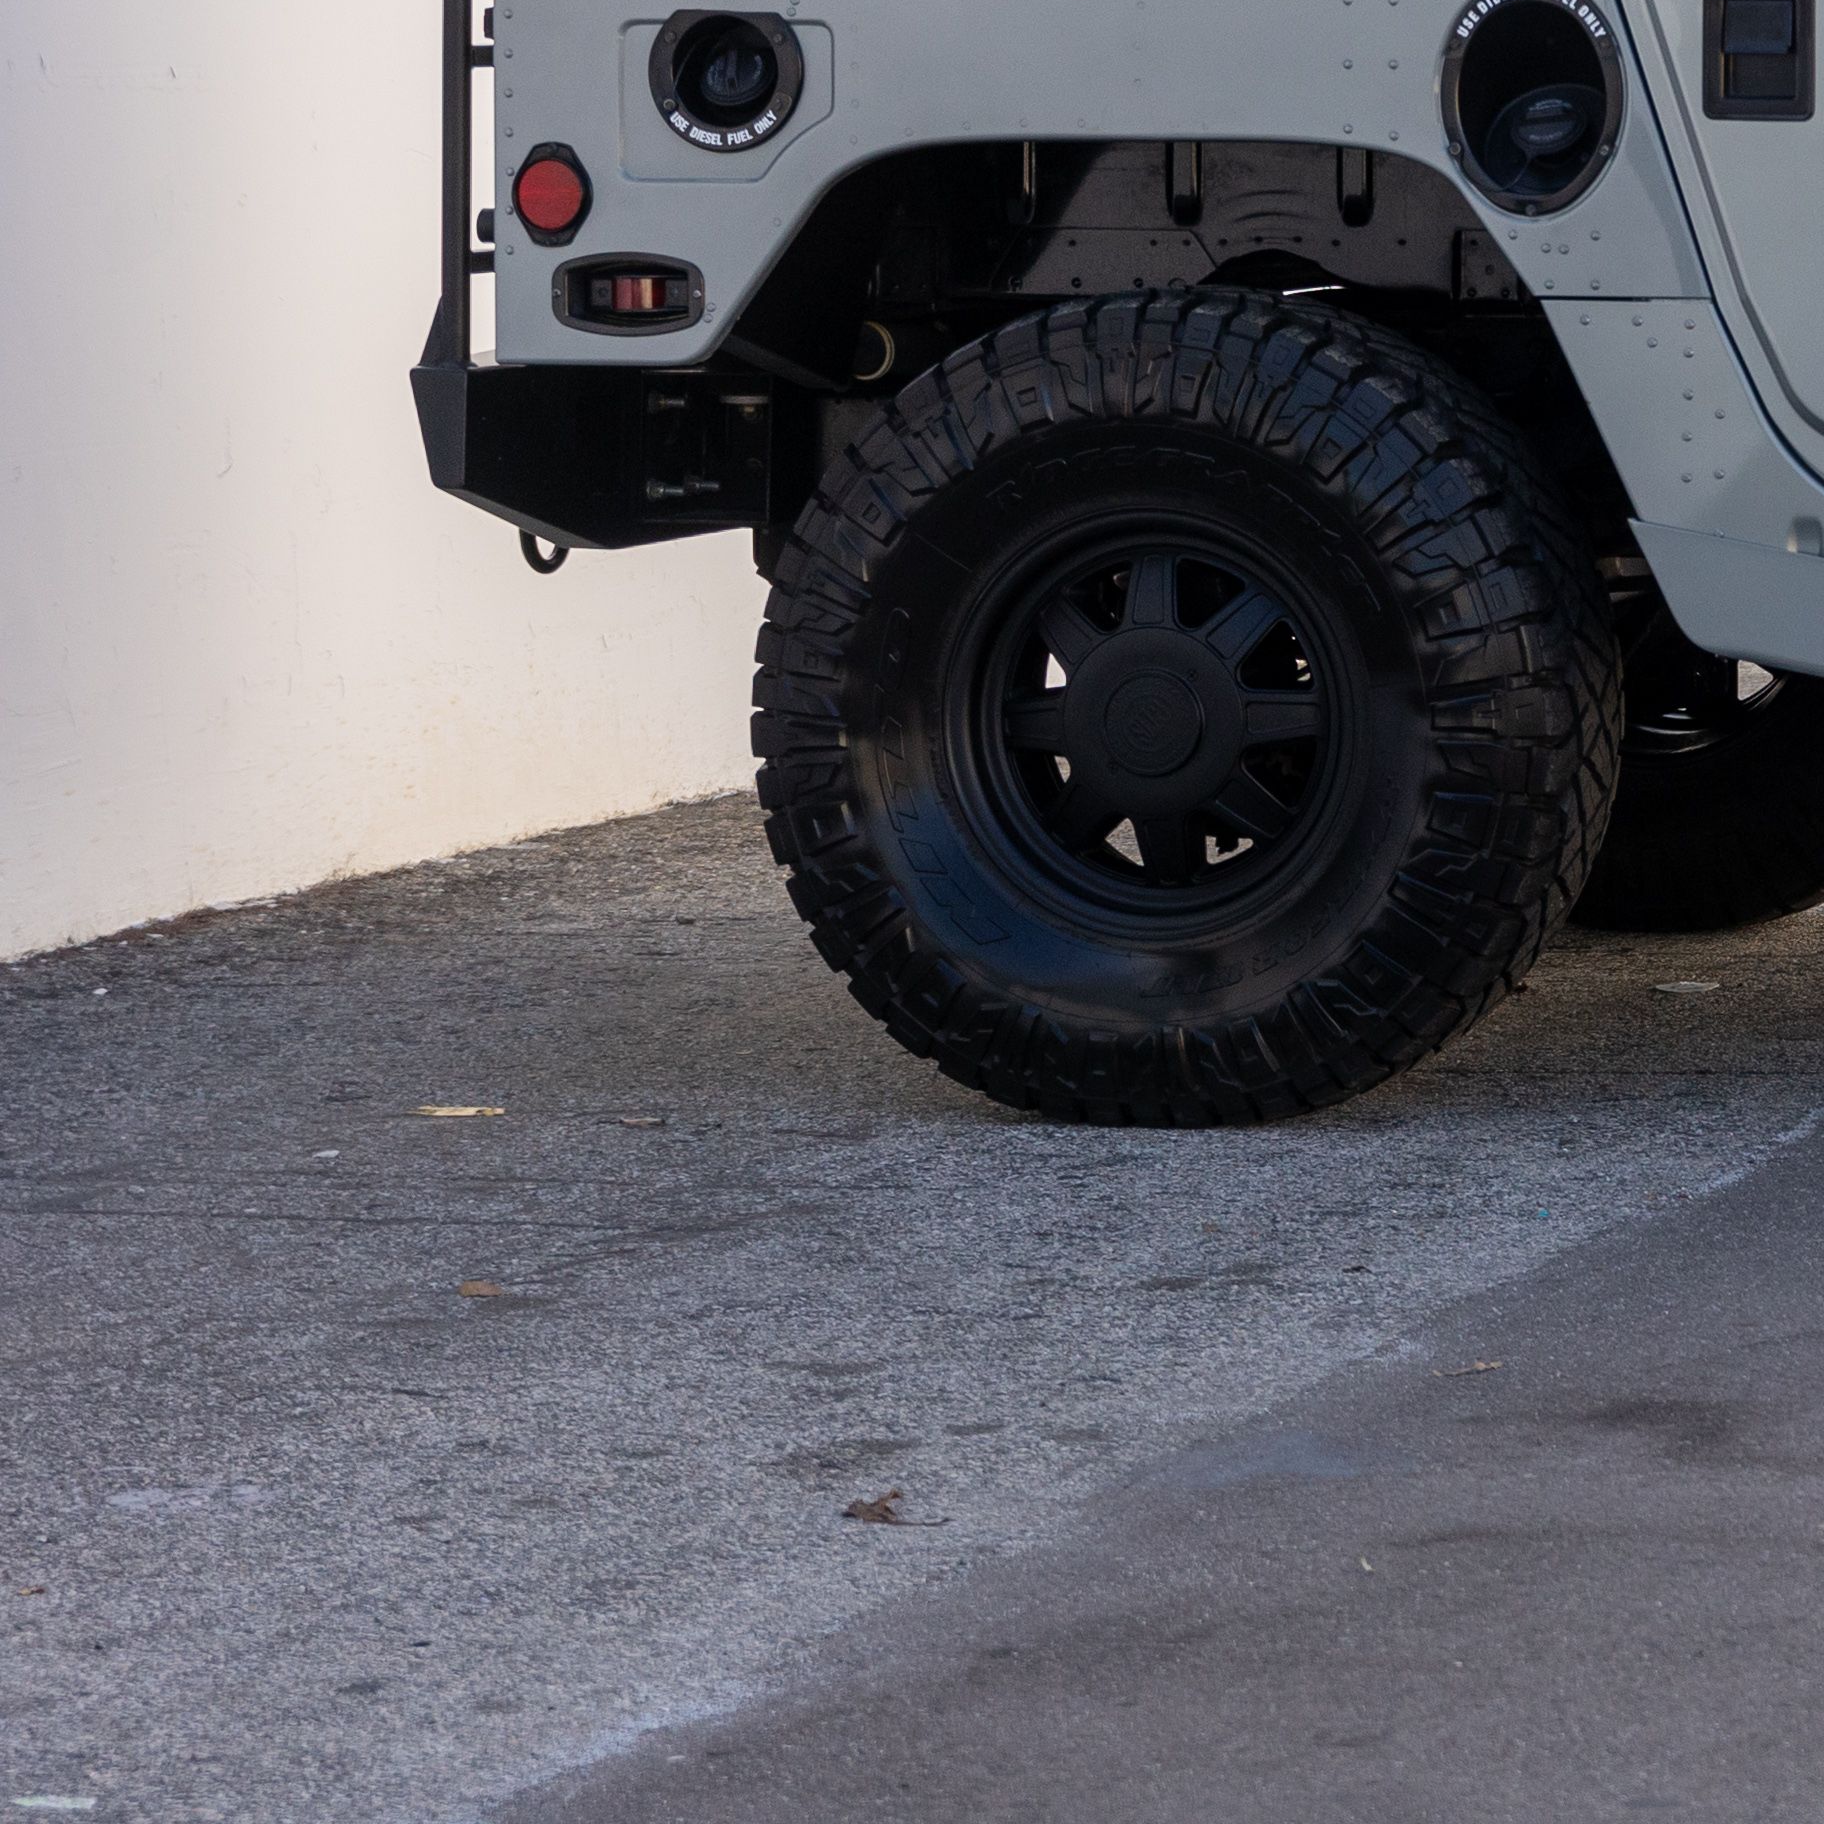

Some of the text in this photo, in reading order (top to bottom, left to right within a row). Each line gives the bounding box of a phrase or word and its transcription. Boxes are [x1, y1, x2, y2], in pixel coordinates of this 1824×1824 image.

[1456, 11, 1480, 40] USE
[1576, 6, 1607, 39] ONLY
[669, 110, 777, 146] USE DIESEL FUEL ONLY
